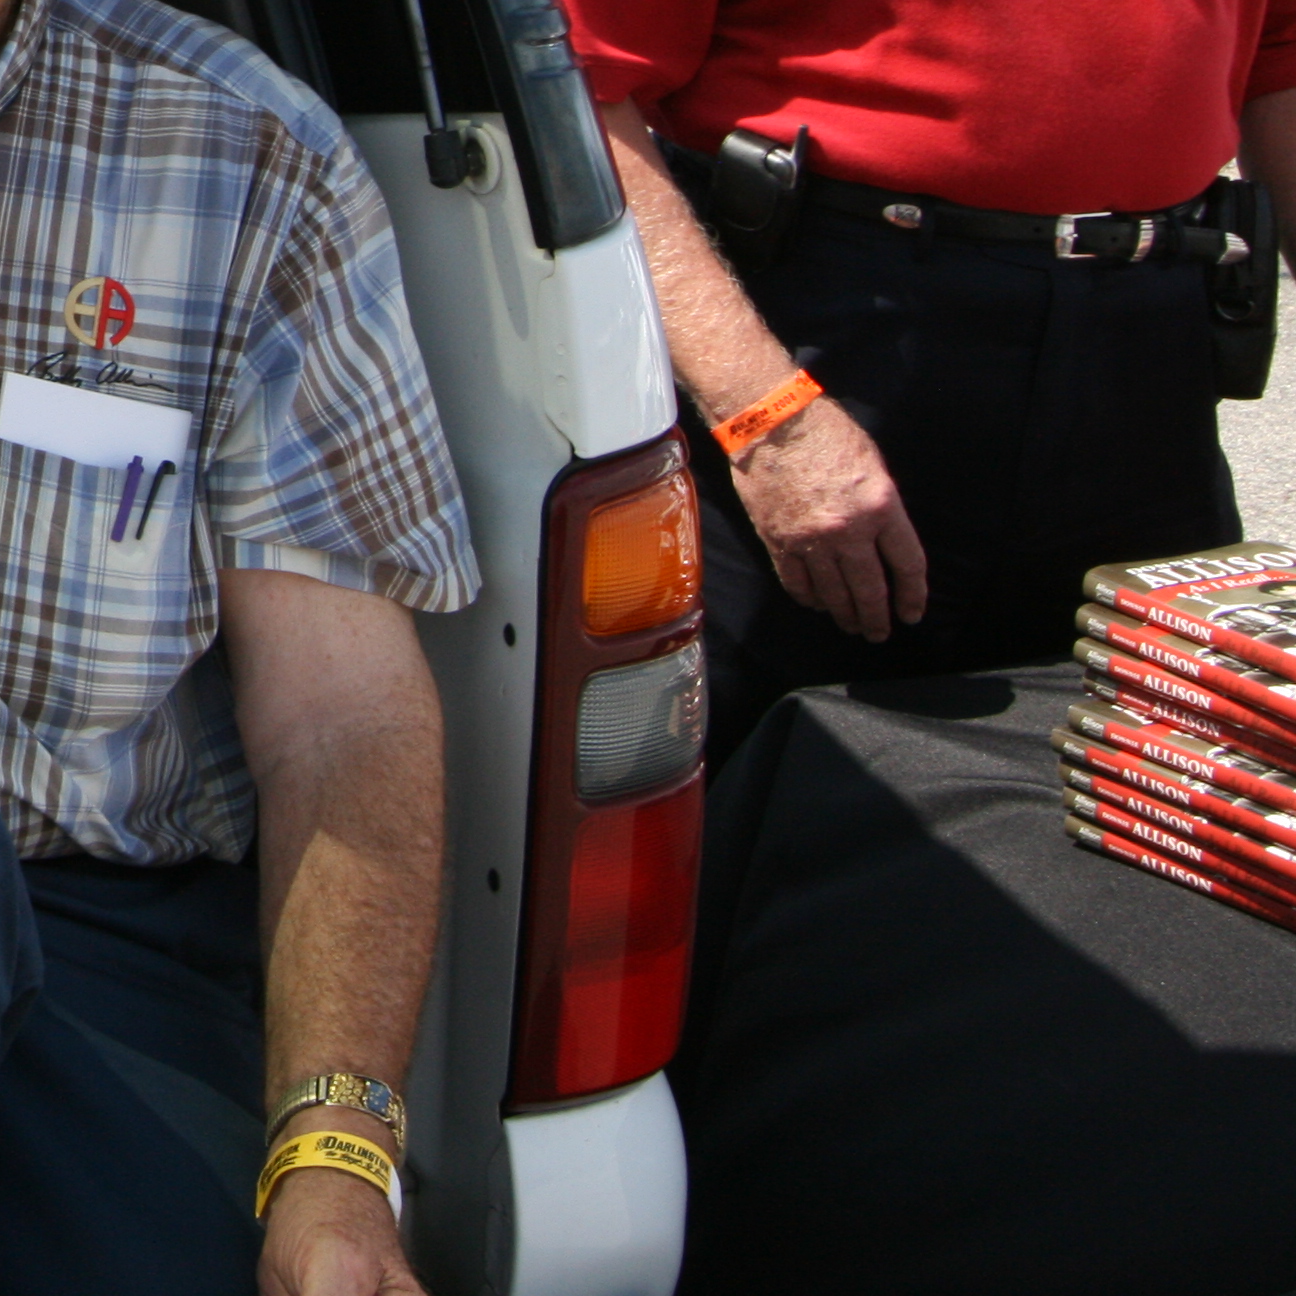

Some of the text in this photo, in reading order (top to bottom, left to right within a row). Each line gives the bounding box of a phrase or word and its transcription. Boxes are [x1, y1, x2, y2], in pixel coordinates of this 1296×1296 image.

[772, 392, 798, 412] 2008
[1148, 607, 1213, 641] ALLISON
[1139, 642, 1201, 677] ALLISON
[1144, 674, 1212, 709] ALLISON
[1152, 702, 1221, 737] ALLISON
[1142, 742, 1216, 779] ALLISON
[1122, 768, 1191, 805] ALLISON
[1127, 797, 1195, 835] ALLISON
[1132, 822, 1204, 862] ALLISON
[1140, 854, 1214, 892] ALLISON
